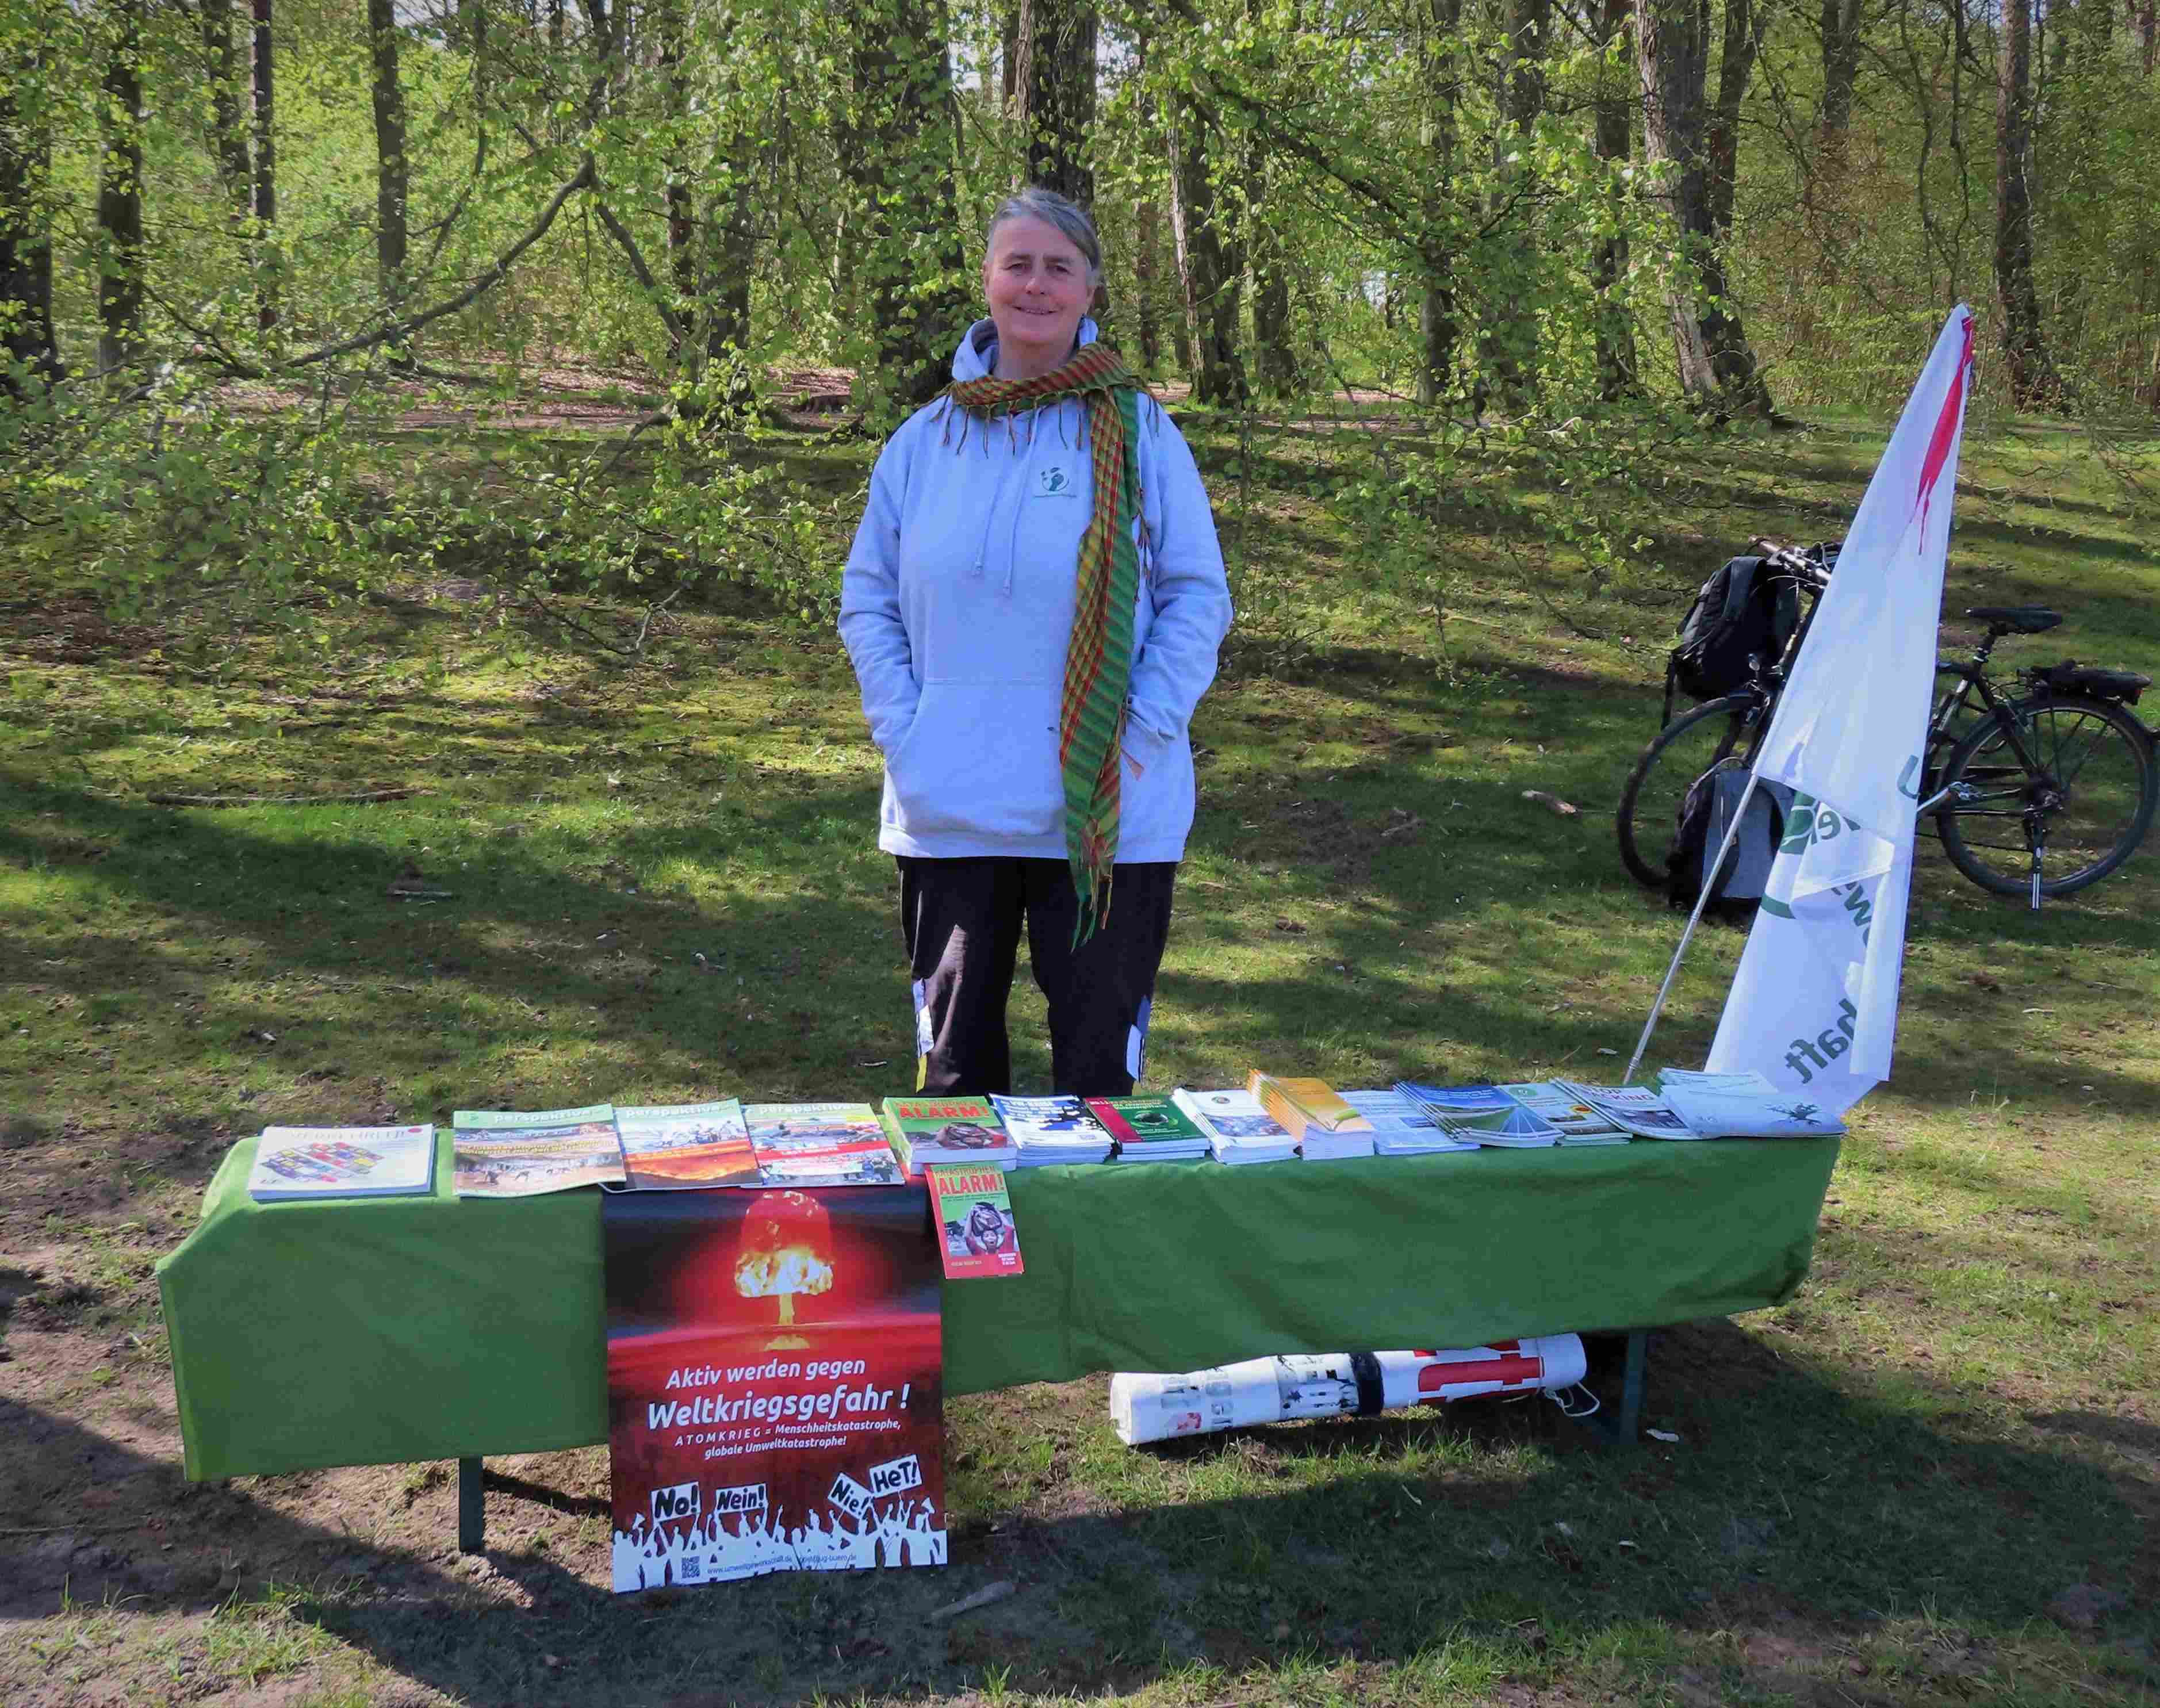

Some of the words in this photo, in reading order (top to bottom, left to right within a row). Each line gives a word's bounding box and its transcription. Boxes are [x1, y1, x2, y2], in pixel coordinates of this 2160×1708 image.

[939, 1174, 1005, 1194] ALARM!
[665, 1365, 722, 1389] Aktiv
[727, 1358, 801, 1383] werden
[806, 1359, 865, 1381] gegen
[648, 1384, 894, 1430] Weltkriegsgefahr
[775, 1418, 902, 1435] Menschheitskatastrophe,
[704, 1444, 742, 1461] globale
[745, 1437, 847, 1453] Umweltkatastrophe!
[654, 1485, 699, 1518] No!
[717, 1485, 765, 1511] Nein!
[831, 1480, 868, 1515] Nie!
